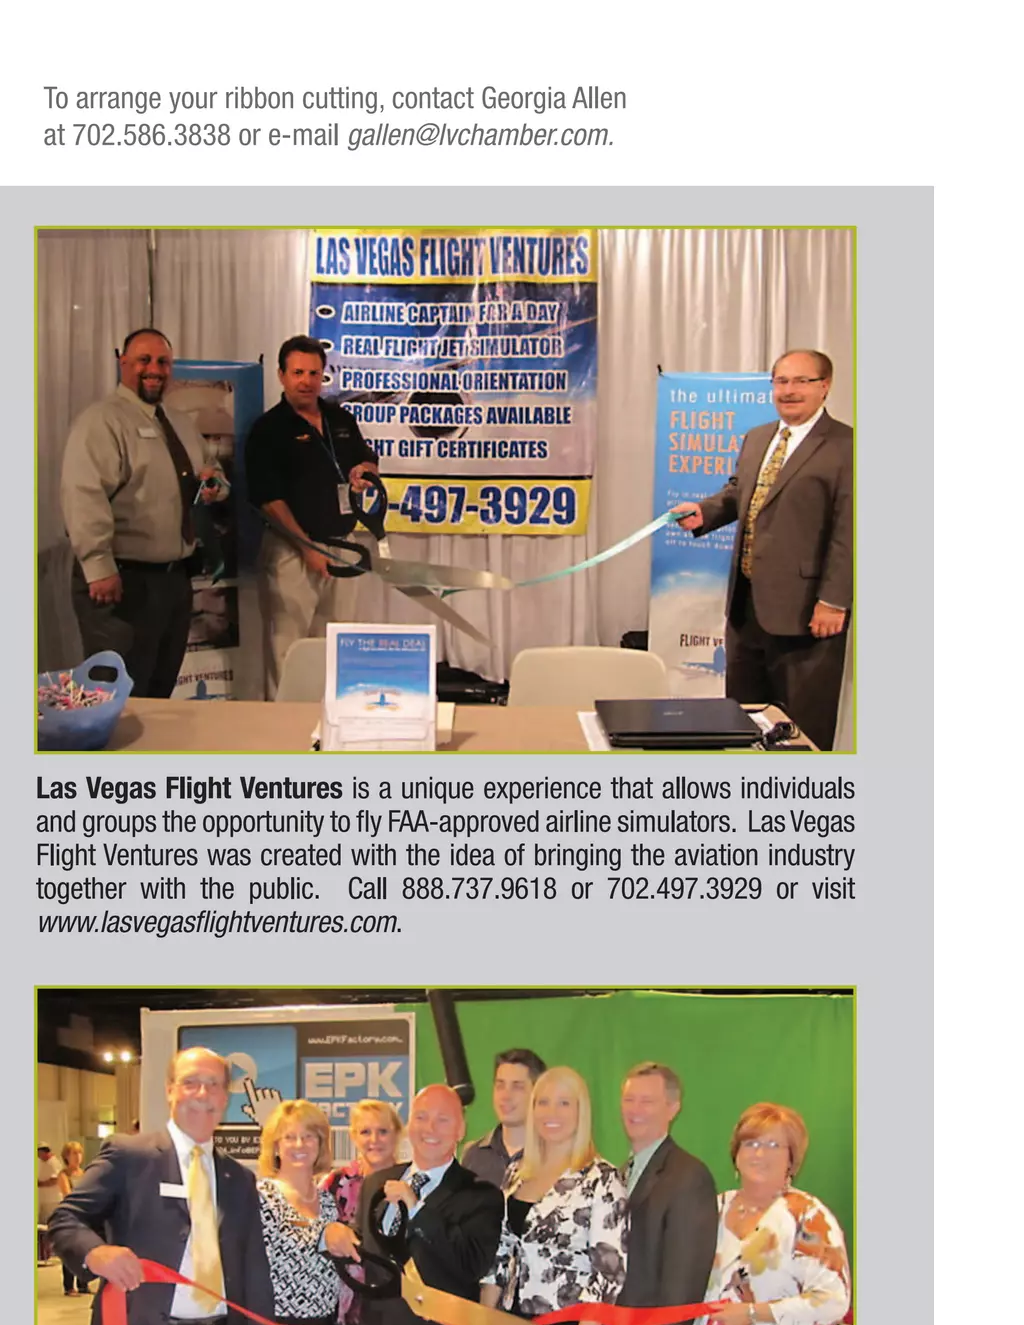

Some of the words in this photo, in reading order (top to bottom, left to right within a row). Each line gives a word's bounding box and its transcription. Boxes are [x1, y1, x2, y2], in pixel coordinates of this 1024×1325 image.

[44, 86, 68, 109] To
[77, 91, 161, 114] arrange
[169, 92, 218, 114] your
[226, 86, 293, 109] ribbon
[303, 86, 384, 114] cutting,
[393, 87, 474, 109] contact
[482, 86, 566, 114] Georgia
[572, 86, 626, 109] Allen
[44, 124, 65, 146] at
[73, 124, 230, 146] 702.586.3838
[239, 128, 261, 146] or
[269, 123, 338, 146] e-mail
[348, 123, 613, 151] gallen@lvchamber.com.
[315, 236, 351, 276] LAS
[354, 236, 414, 277] VEGAS
[419, 236, 485, 277] FLIGHT
[490, 235, 589, 276] VENTURES
[342, 302, 405, 324] AIRLINE
[408, 302, 474, 325] CAPTAIN
[511, 303, 524, 323] A
[527, 302, 561, 324] DAY
[341, 336, 383, 357] REAL
[384, 336, 439, 358] FLIGHT
[441, 337, 466, 358] JET
[469, 336, 565, 358] SIMULATOR
[341, 371, 460, 391] PROFESSIONAL
[462, 370, 567, 391] ORIENTATION
[670, 388, 698, 404] the
[707, 389, 773, 405] ultimat
[343, 403, 396, 424] GROUP
[399, 404, 483, 426] PACKAGES
[486, 406, 572, 426] AVAILABLE
[669, 410, 736, 431] FLIGHT
[398, 438, 433, 459] GIFT
[436, 440, 549, 460] CERTIFICATES
[668, 432, 745, 453] SIMULA
[668, 454, 736, 476] EXPERI
[679, 633, 711, 648] FLIGHT
[39, 910, 401, 938] www.lasvegasflightventures.com.
[304, 1060, 403, 1099] EPK
